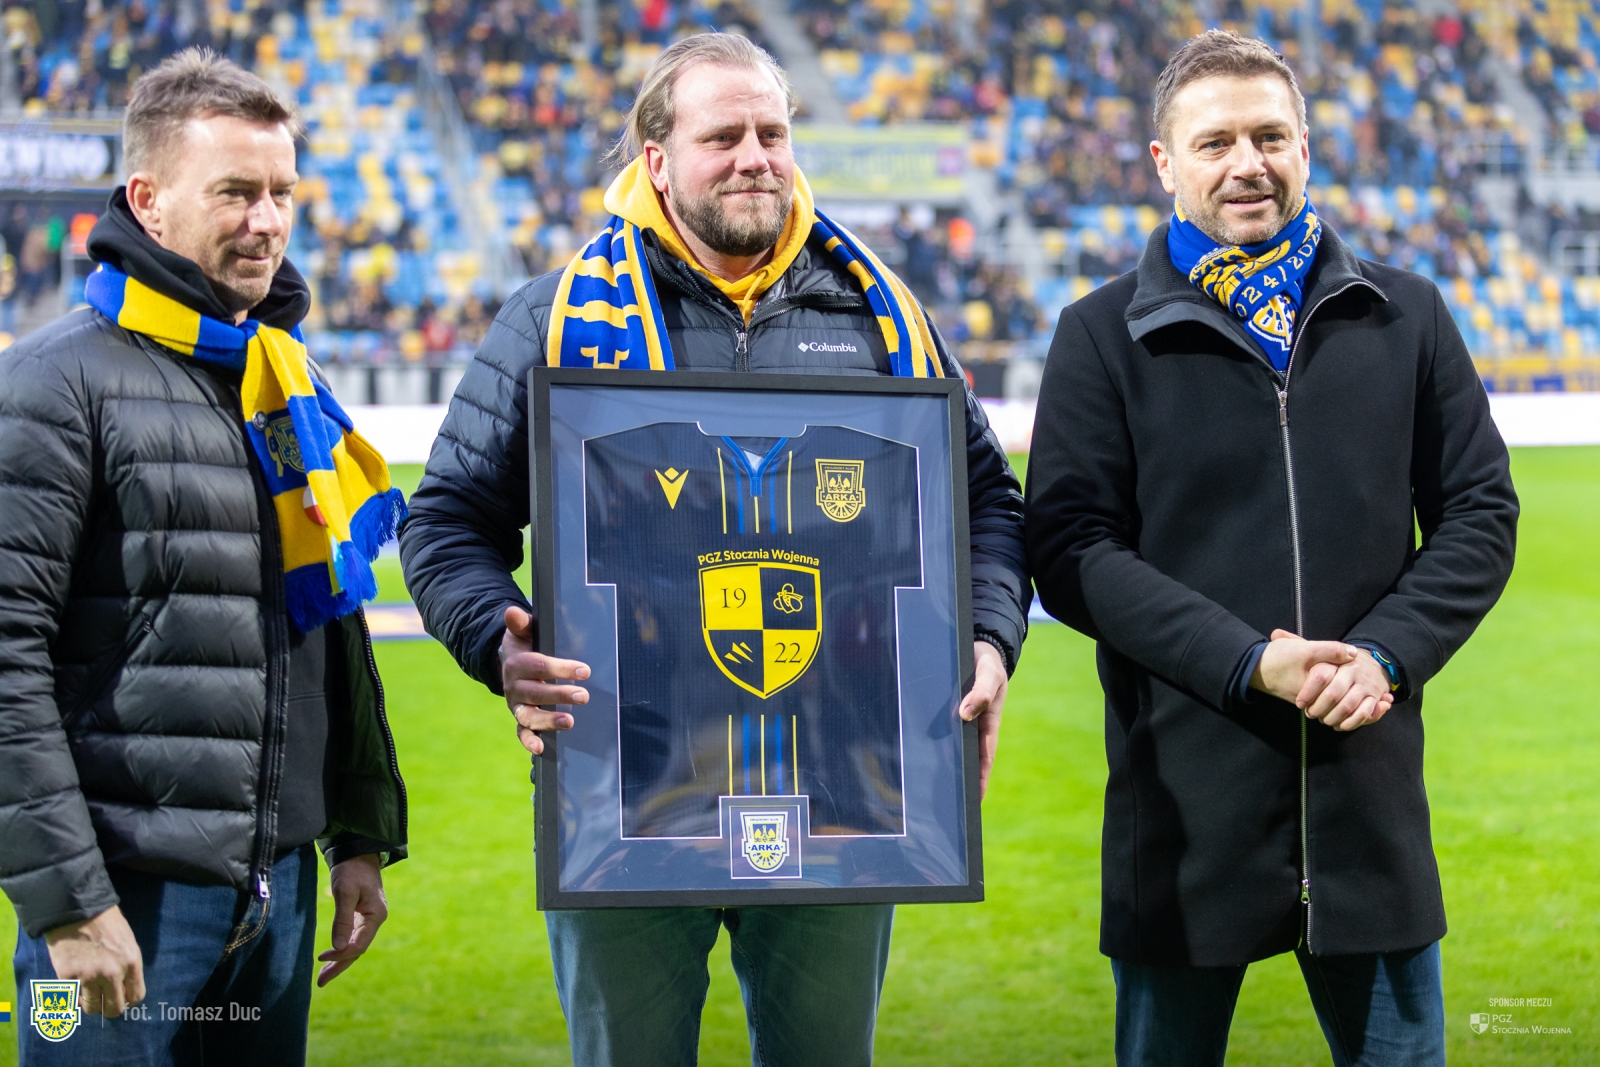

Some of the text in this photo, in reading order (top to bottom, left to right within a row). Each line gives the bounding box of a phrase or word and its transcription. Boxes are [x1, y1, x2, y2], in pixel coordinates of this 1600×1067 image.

[809, 342, 857, 352] Columbia
[825, 493, 856, 501] ARKA
[697, 548, 820, 567] PGZ Stocznia Wojenna
[720, 587, 747, 609] 19
[773, 642, 802, 664] 22
